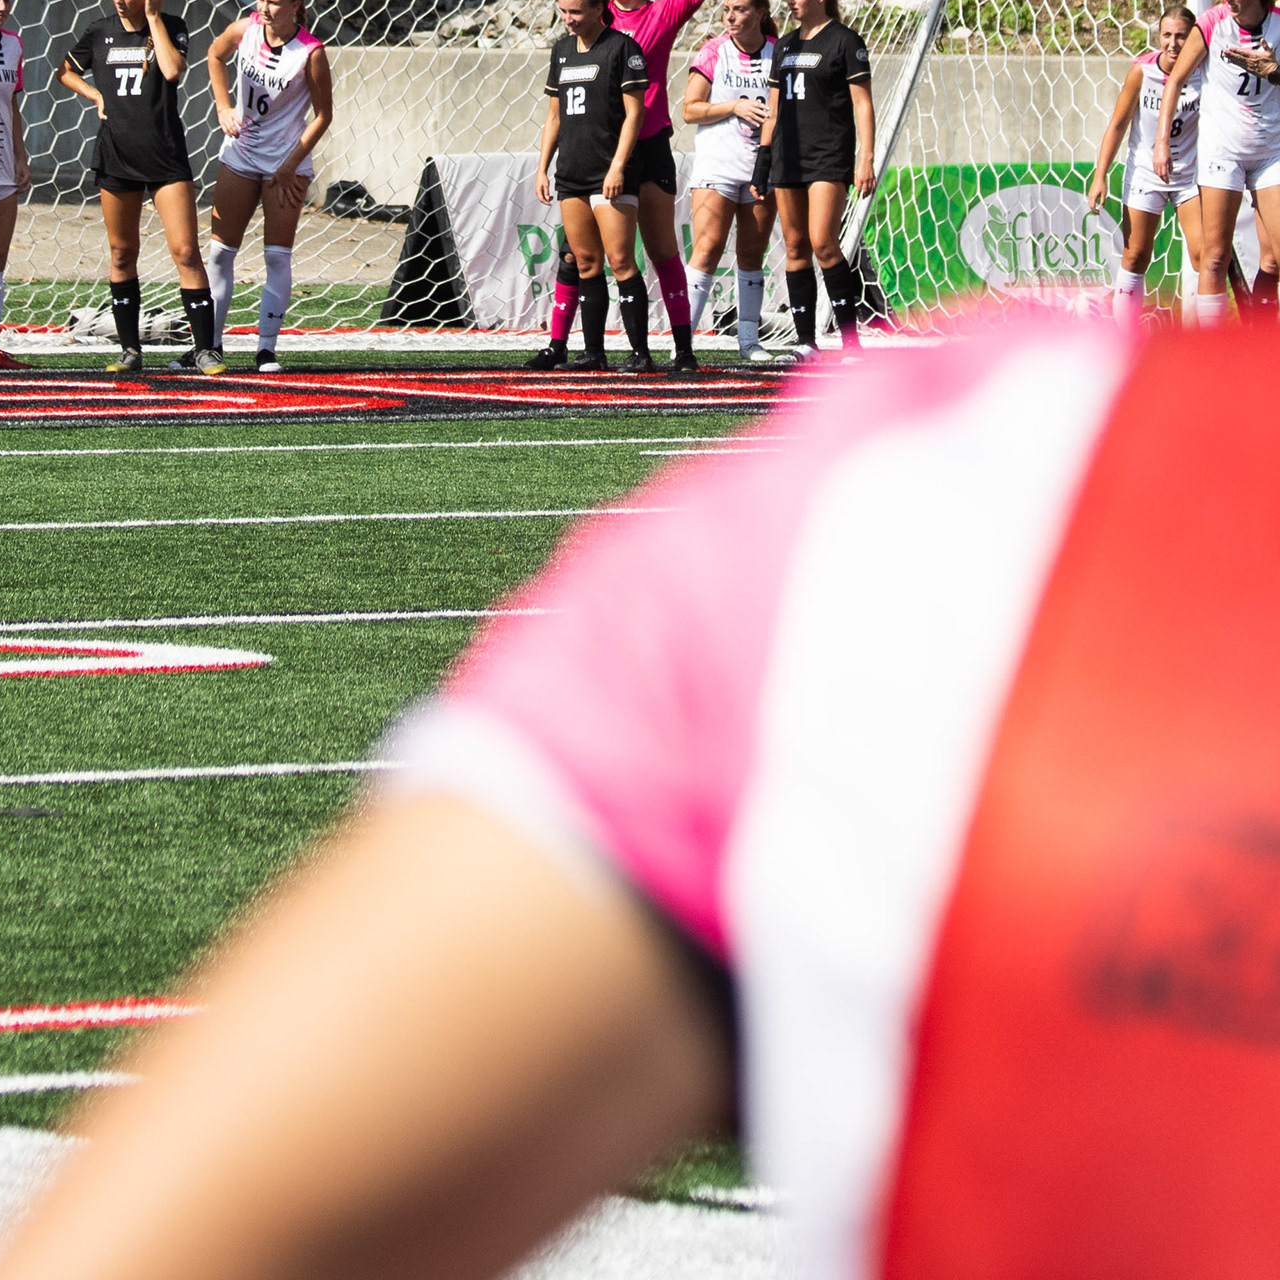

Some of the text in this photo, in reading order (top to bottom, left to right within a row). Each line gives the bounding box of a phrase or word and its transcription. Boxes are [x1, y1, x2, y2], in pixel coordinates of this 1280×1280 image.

[115, 68, 143, 96] 77
[785, 72, 806, 100] 14
[1237, 72, 1261, 96] 21
[247, 85, 269, 116] 16
[566, 86, 586, 115] 12
[1004, 211, 1107, 288] fresh
